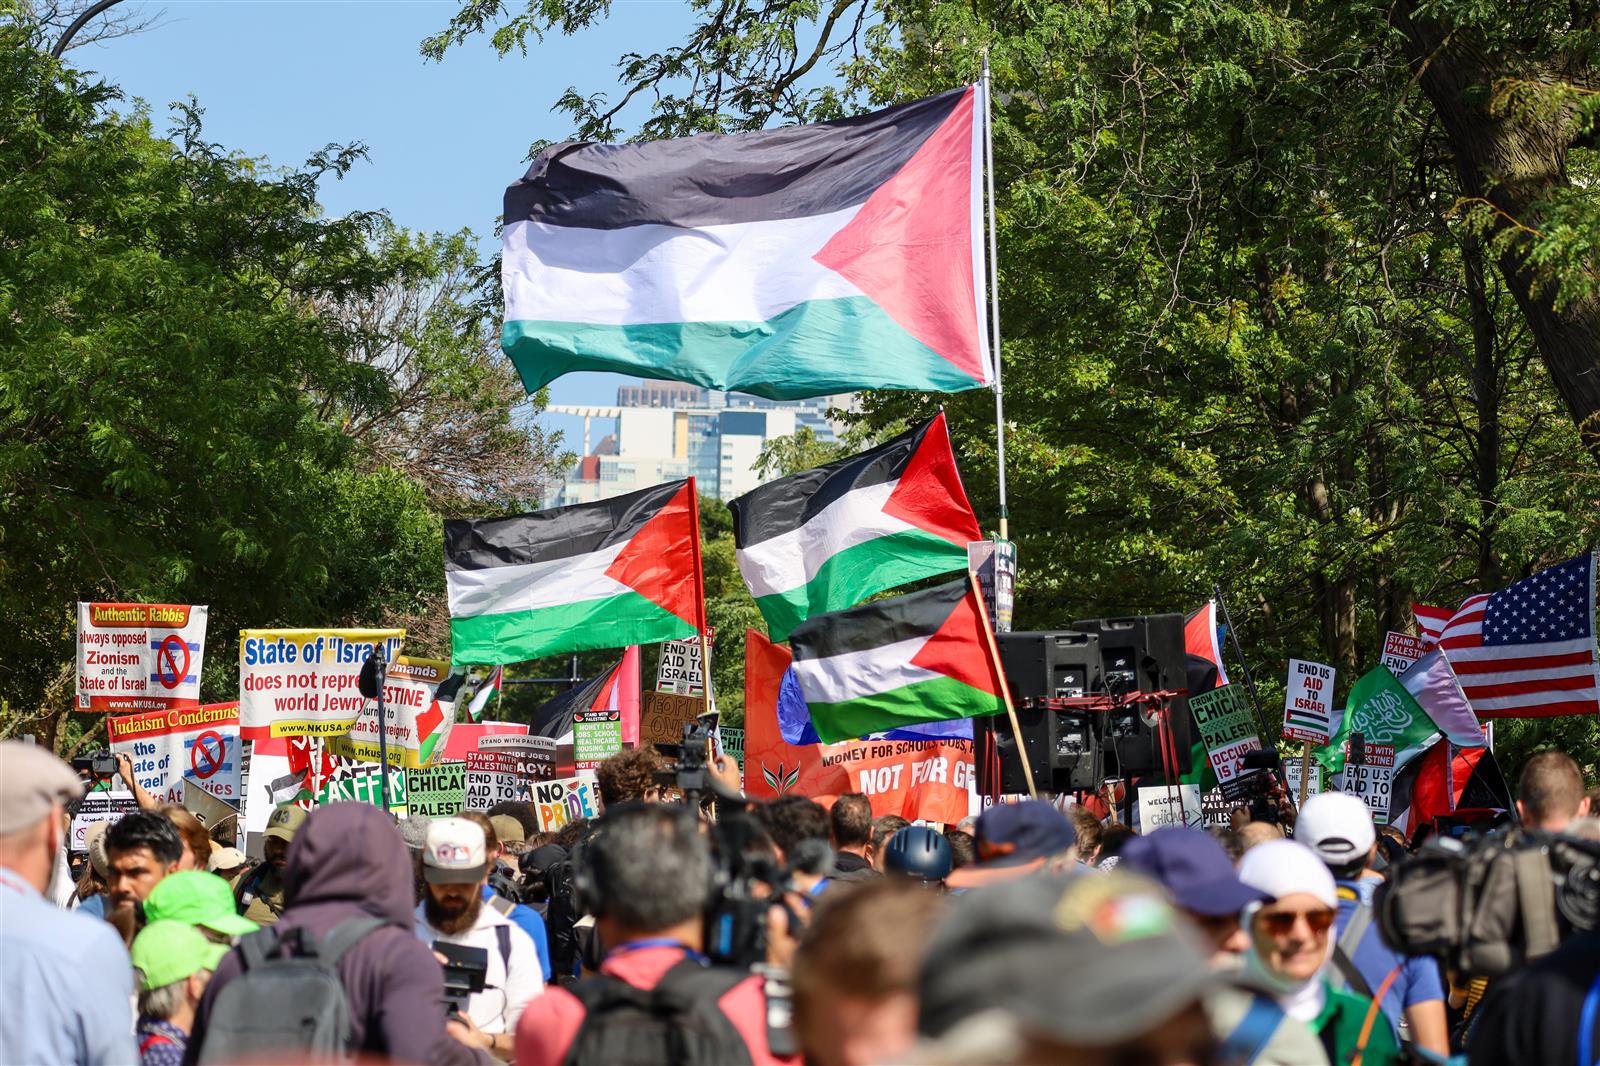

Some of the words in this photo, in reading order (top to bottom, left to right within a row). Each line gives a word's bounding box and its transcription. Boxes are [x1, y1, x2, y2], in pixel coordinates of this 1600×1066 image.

[94, 606, 146, 622] Authentic
[150, 607, 185, 623] Rabbis
[80, 631, 110, 648] always
[112, 631, 146, 648] opposed
[1389, 634, 1415, 646] STAND
[245, 638, 297, 664] State
[302, 636, 324, 664] of
[329, 638, 400, 664] "Isral"
[664, 643, 686, 655] END
[690, 648, 700, 658] U.
[86, 651, 140, 665] Zionism
[662, 655, 684, 668] AID
[1386, 656, 1408, 670] END
[101, 668, 114, 676] and
[116, 667, 128, 676] the
[1298, 663, 1318, 676] END
[1320, 668, 1330, 680] US
[79, 676, 105, 690] State
[108, 676, 118, 690] of
[122, 676, 147, 690] Israel
[244, 673, 282, 692] does
[286, 672, 317, 689] not
[322, 673, 360, 692] repre
[1303, 677, 1323, 691] AID
[1190, 692, 1213, 708] FROM
[1307, 690, 1318, 700] TO
[109, 700, 166, 710] www.NKUSA.org
[275, 693, 318, 712] world
[322, 694, 366, 714] Jewry
[1294, 698, 1326, 714] ISRAEL
[387, 708, 395, 720] to
[112, 715, 166, 737] Judaism
[166, 706, 239, 727] Condemns
[280, 722, 352, 734] www.NKUSA.o
[369, 721, 411, 740] Soereignty
[134, 742, 156, 756] the
[522, 739, 554, 748] PALESTINE
[1375, 745, 1394, 756] WITH
[342, 742, 402, 762] www.nkus.org
[468, 752, 495, 762] STAND
[497, 755, 516, 764] WITH
[822, 749, 868, 768] MONEY
[871, 744, 893, 759] FOR
[158, 754, 170, 770] of
[468, 761, 516, 773] PALESTINE!
[517, 762, 552, 776] ACY:
[408, 768, 432, 776] FROM
[468, 774, 492, 784] END
[860, 763, 904, 796] NOT
[910, 756, 948, 788] FOR
[1218, 766, 1232, 779] IS
[1346, 766, 1368, 778] END
[408, 774, 466, 792] CHICA
[1344, 780, 1368, 792] AID
[1372, 782, 1390, 795] TO
[468, 786, 491, 796] AID
[496, 786, 514, 798] TO
[536, 783, 564, 804] NO
[1148, 796, 1182, 806] WELCOME
[410, 802, 465, 816] PALEST
